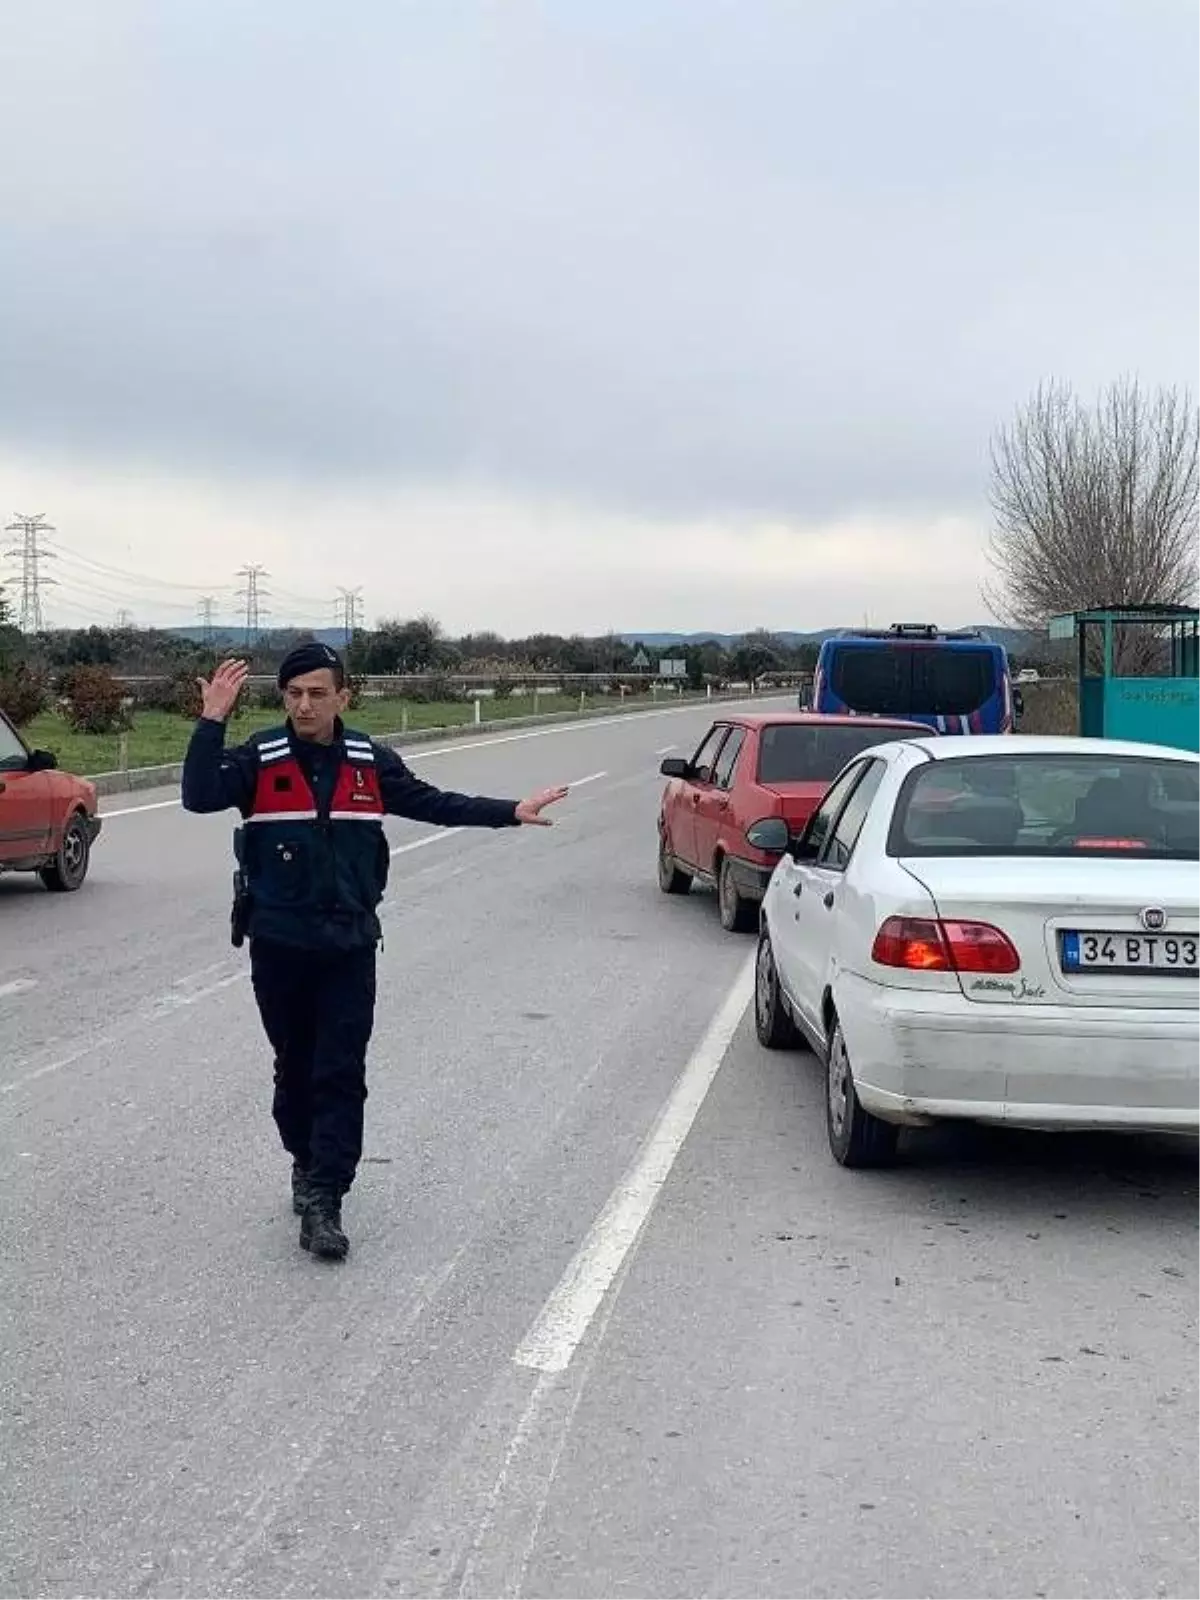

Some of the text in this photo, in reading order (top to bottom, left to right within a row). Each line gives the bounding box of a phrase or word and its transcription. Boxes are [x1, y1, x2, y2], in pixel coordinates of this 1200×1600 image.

[1084, 937, 1197, 965] 34 BT 93
